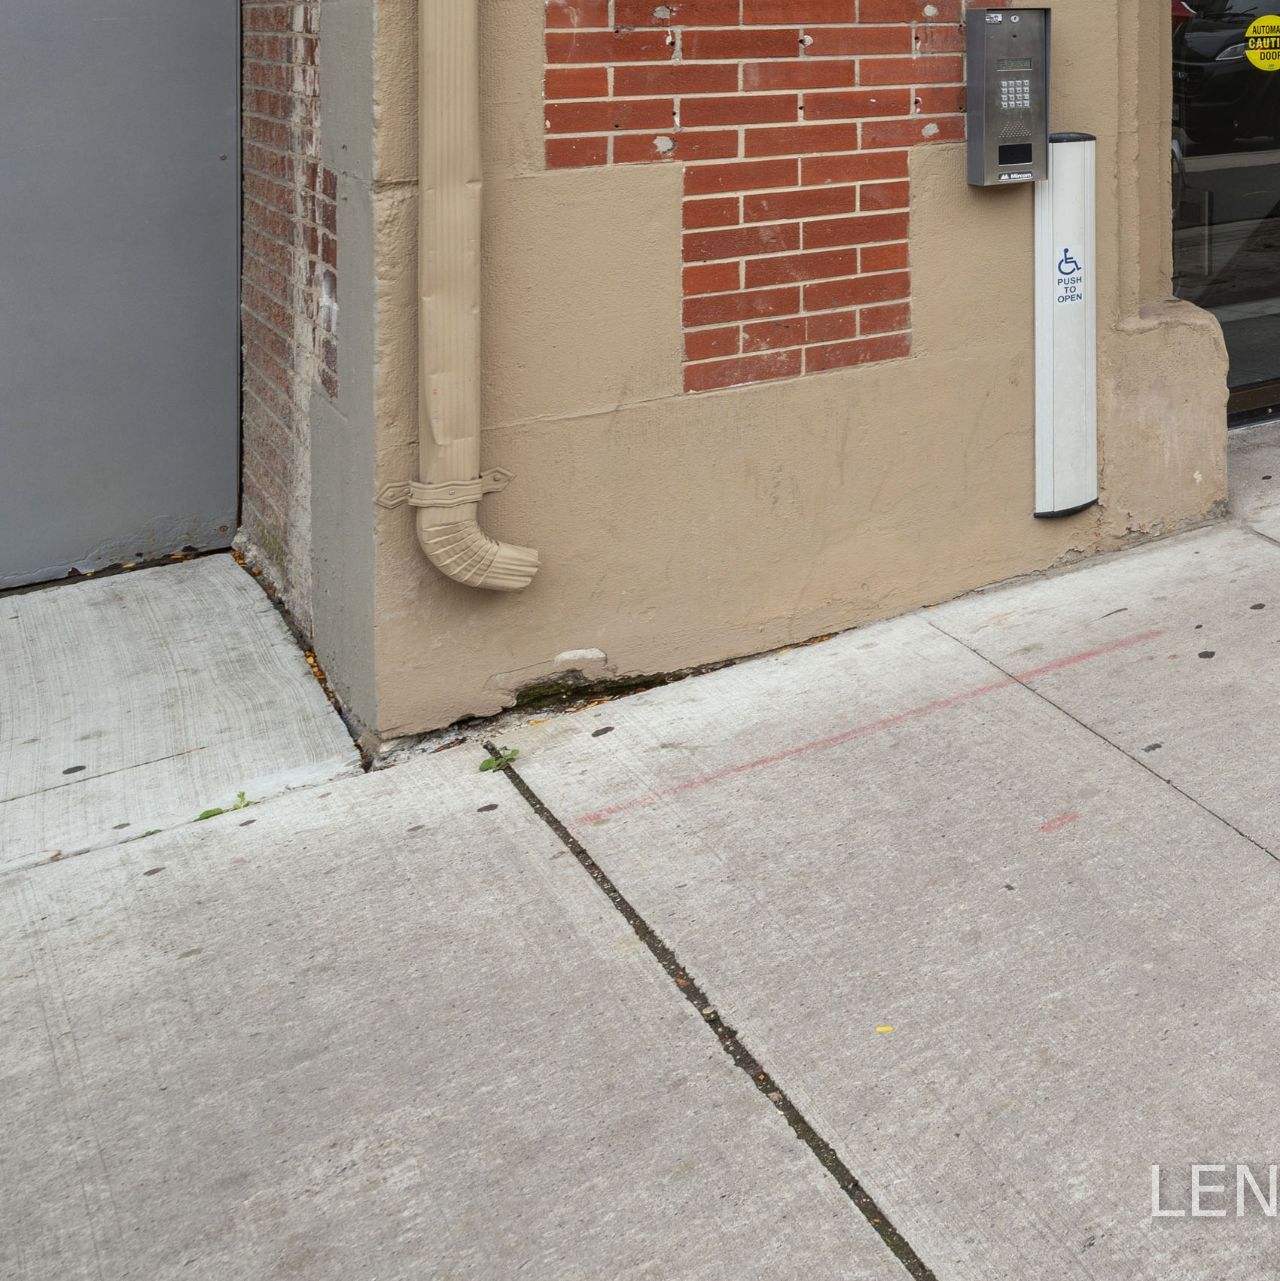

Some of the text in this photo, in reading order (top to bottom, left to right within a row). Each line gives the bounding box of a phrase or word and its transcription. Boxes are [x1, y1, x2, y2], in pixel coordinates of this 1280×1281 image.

[1057, 276, 1082, 286] PUSH
[1064, 286, 1077, 294] TO
[1057, 293, 1083, 303] OPEN
